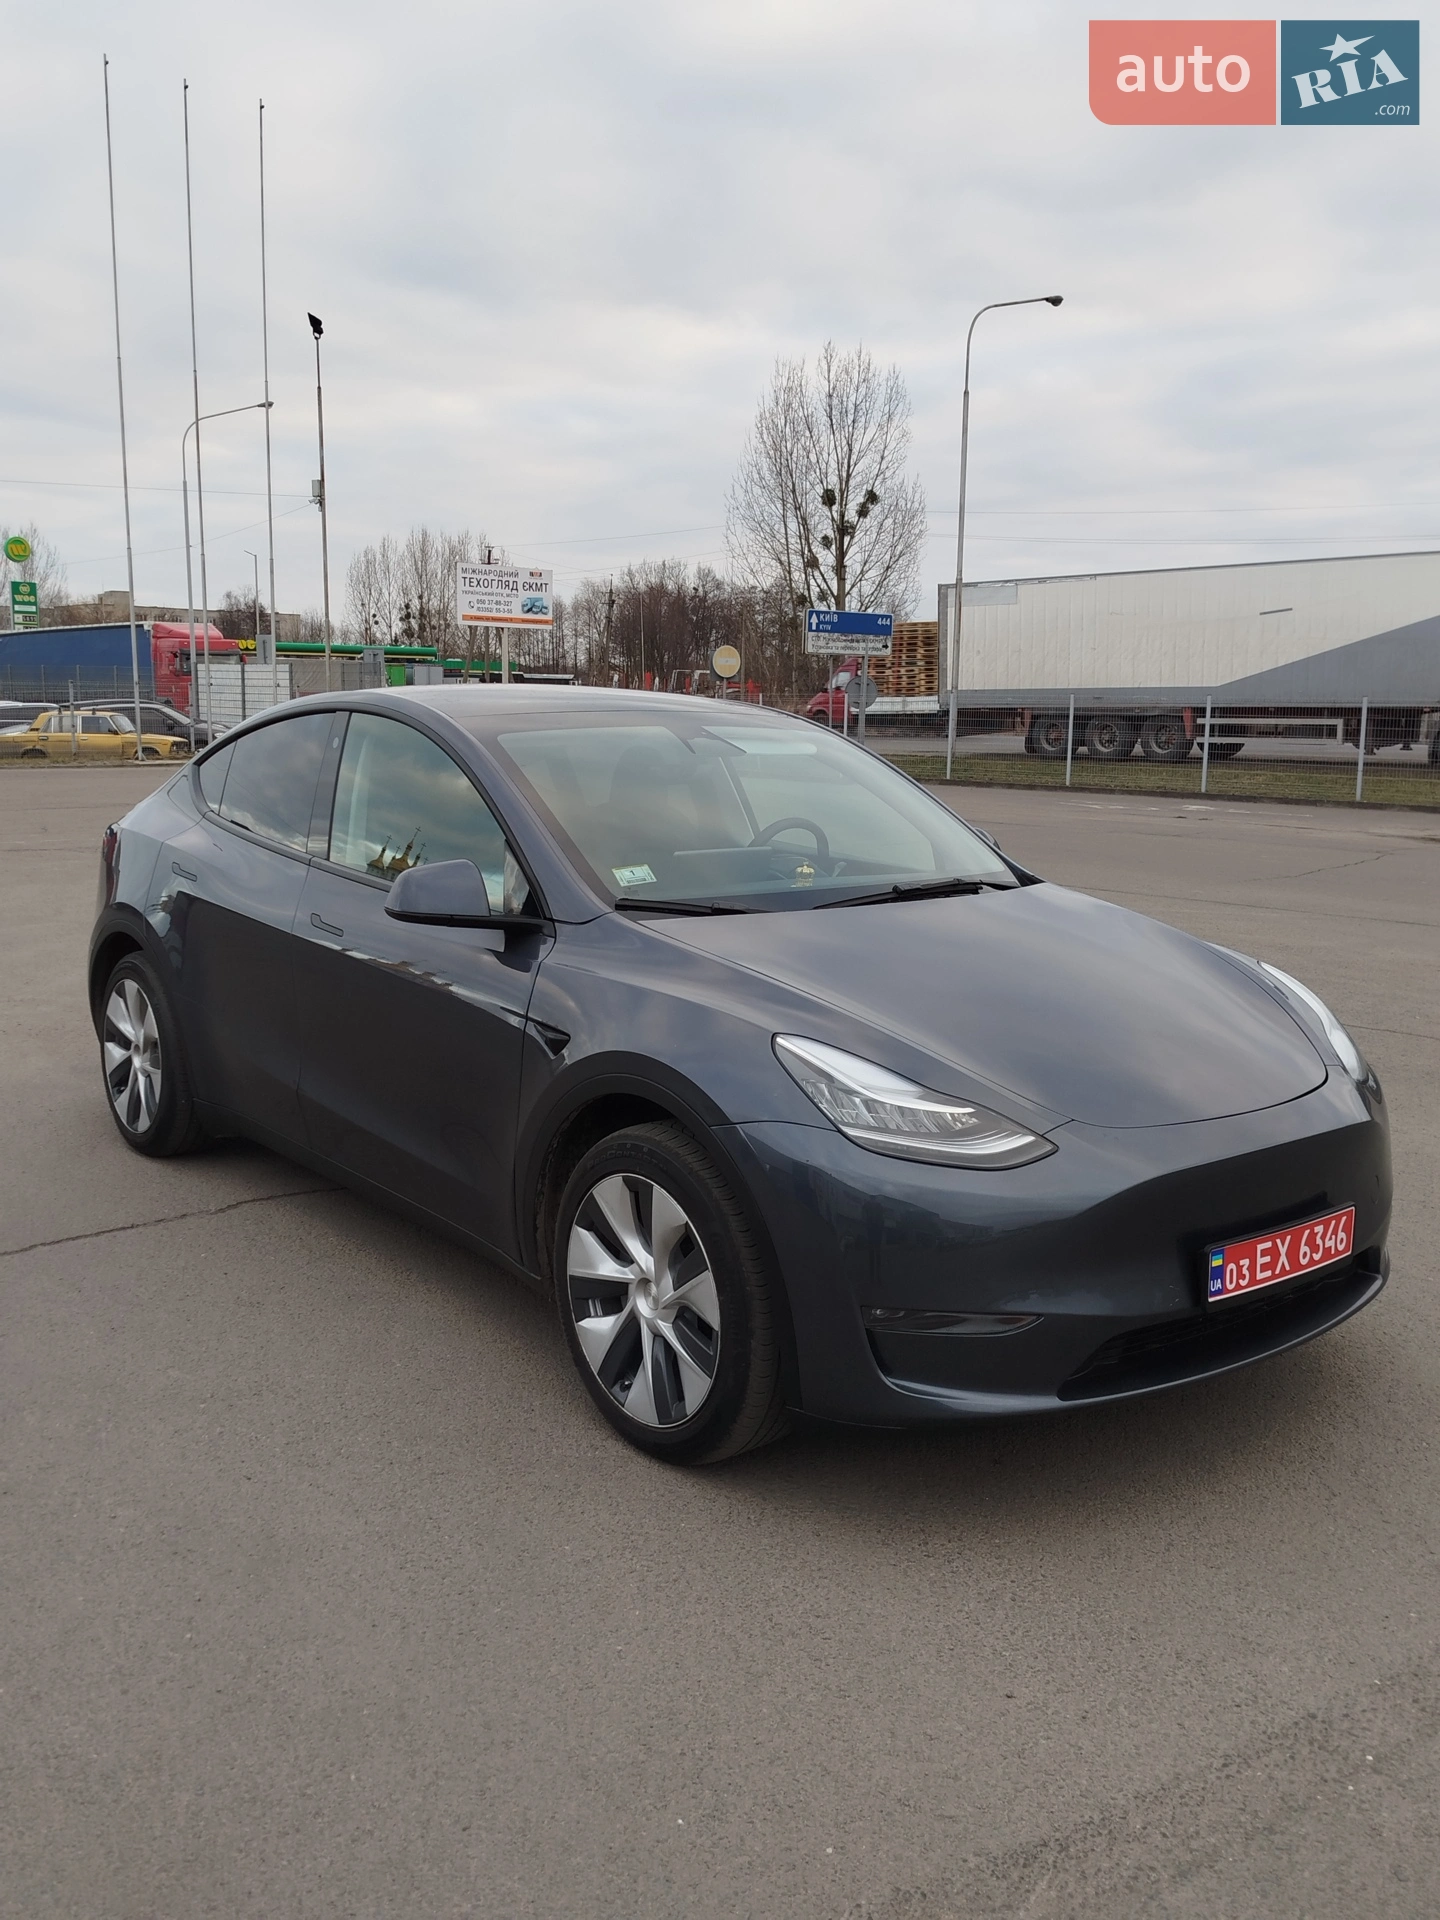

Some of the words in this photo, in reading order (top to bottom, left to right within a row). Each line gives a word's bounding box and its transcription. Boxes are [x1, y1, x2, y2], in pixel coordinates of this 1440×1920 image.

[461, 567, 519, 579] МІЖНАРОДНИЙ
[461, 576, 519, 593] ТЕХОГЛЯД
[522, 581, 549, 593] ЄКМТ
[820, 612, 838, 623] КИЇВ
[877, 618, 891, 626] 444
[239, 640, 256, 649] OG
[1225, 1258, 1250, 1290] 03
[1256, 1235, 1292, 1281] EX
[1299, 1216, 1347, 1266] 6346
[1210, 1278, 1222, 1292] UA
